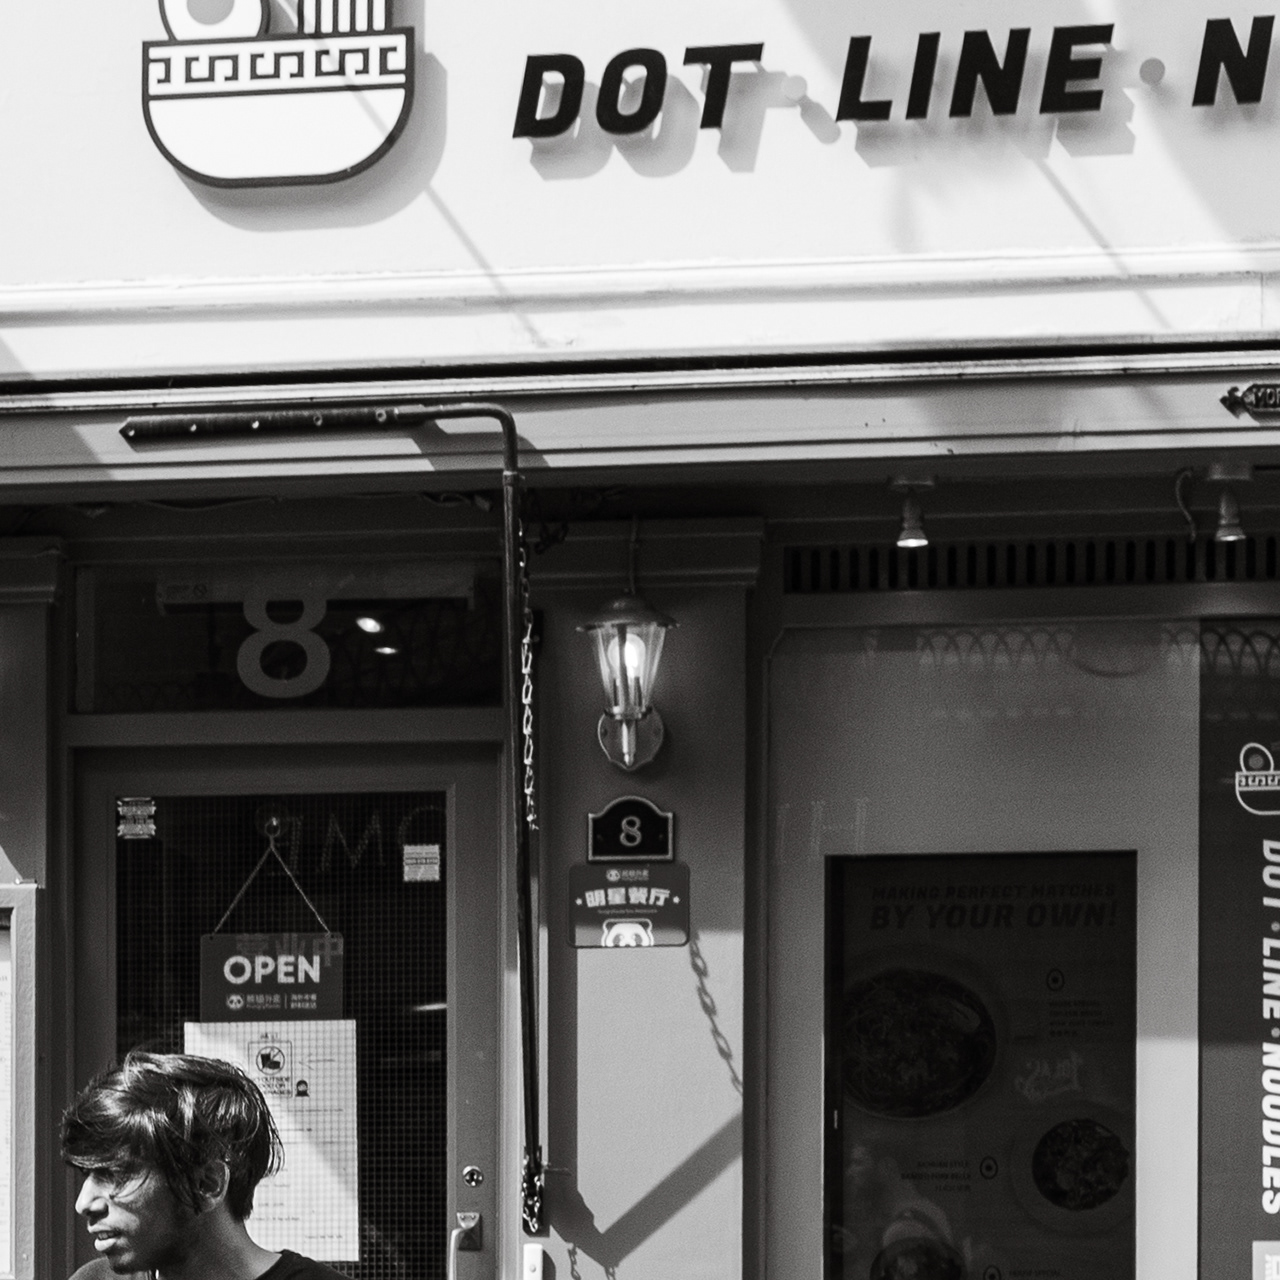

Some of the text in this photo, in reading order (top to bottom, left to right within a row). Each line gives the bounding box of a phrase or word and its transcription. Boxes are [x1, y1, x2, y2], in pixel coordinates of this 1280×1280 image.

[512, 41, 765, 139] DOT
[836, 23, 1116, 122] LINE
[236, 598, 332, 698] 8
[619, 815, 643, 847] 8
[223, 954, 321, 985] OPEN
